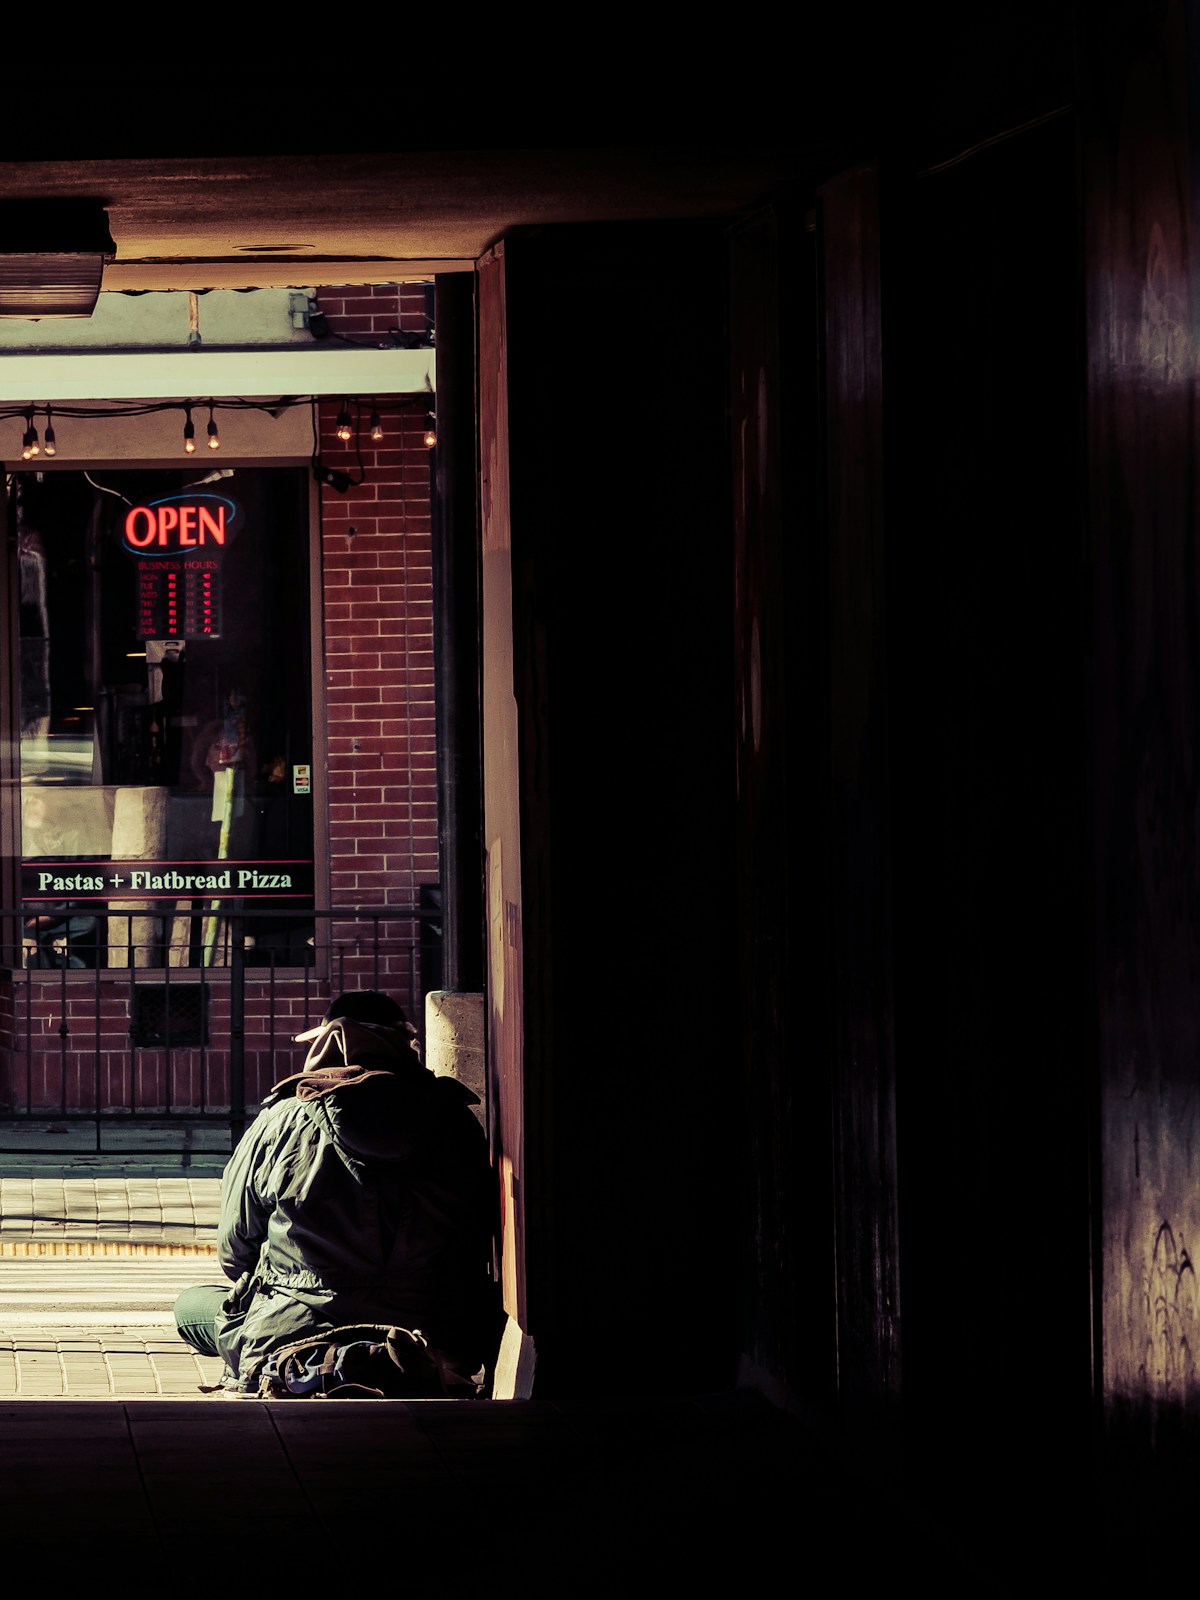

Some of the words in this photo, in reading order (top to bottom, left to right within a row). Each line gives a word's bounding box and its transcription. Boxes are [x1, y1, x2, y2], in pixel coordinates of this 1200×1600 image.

[125, 506, 225, 547] OPEN
[138, 561, 181, 571] BUSINESS
[184, 560, 218, 570] HOURS
[38, 872, 104, 892] Pastas
[109, 873, 125, 889] +
[130, 871, 232, 890] Flatbread
[237, 870, 292, 889] Pizza
